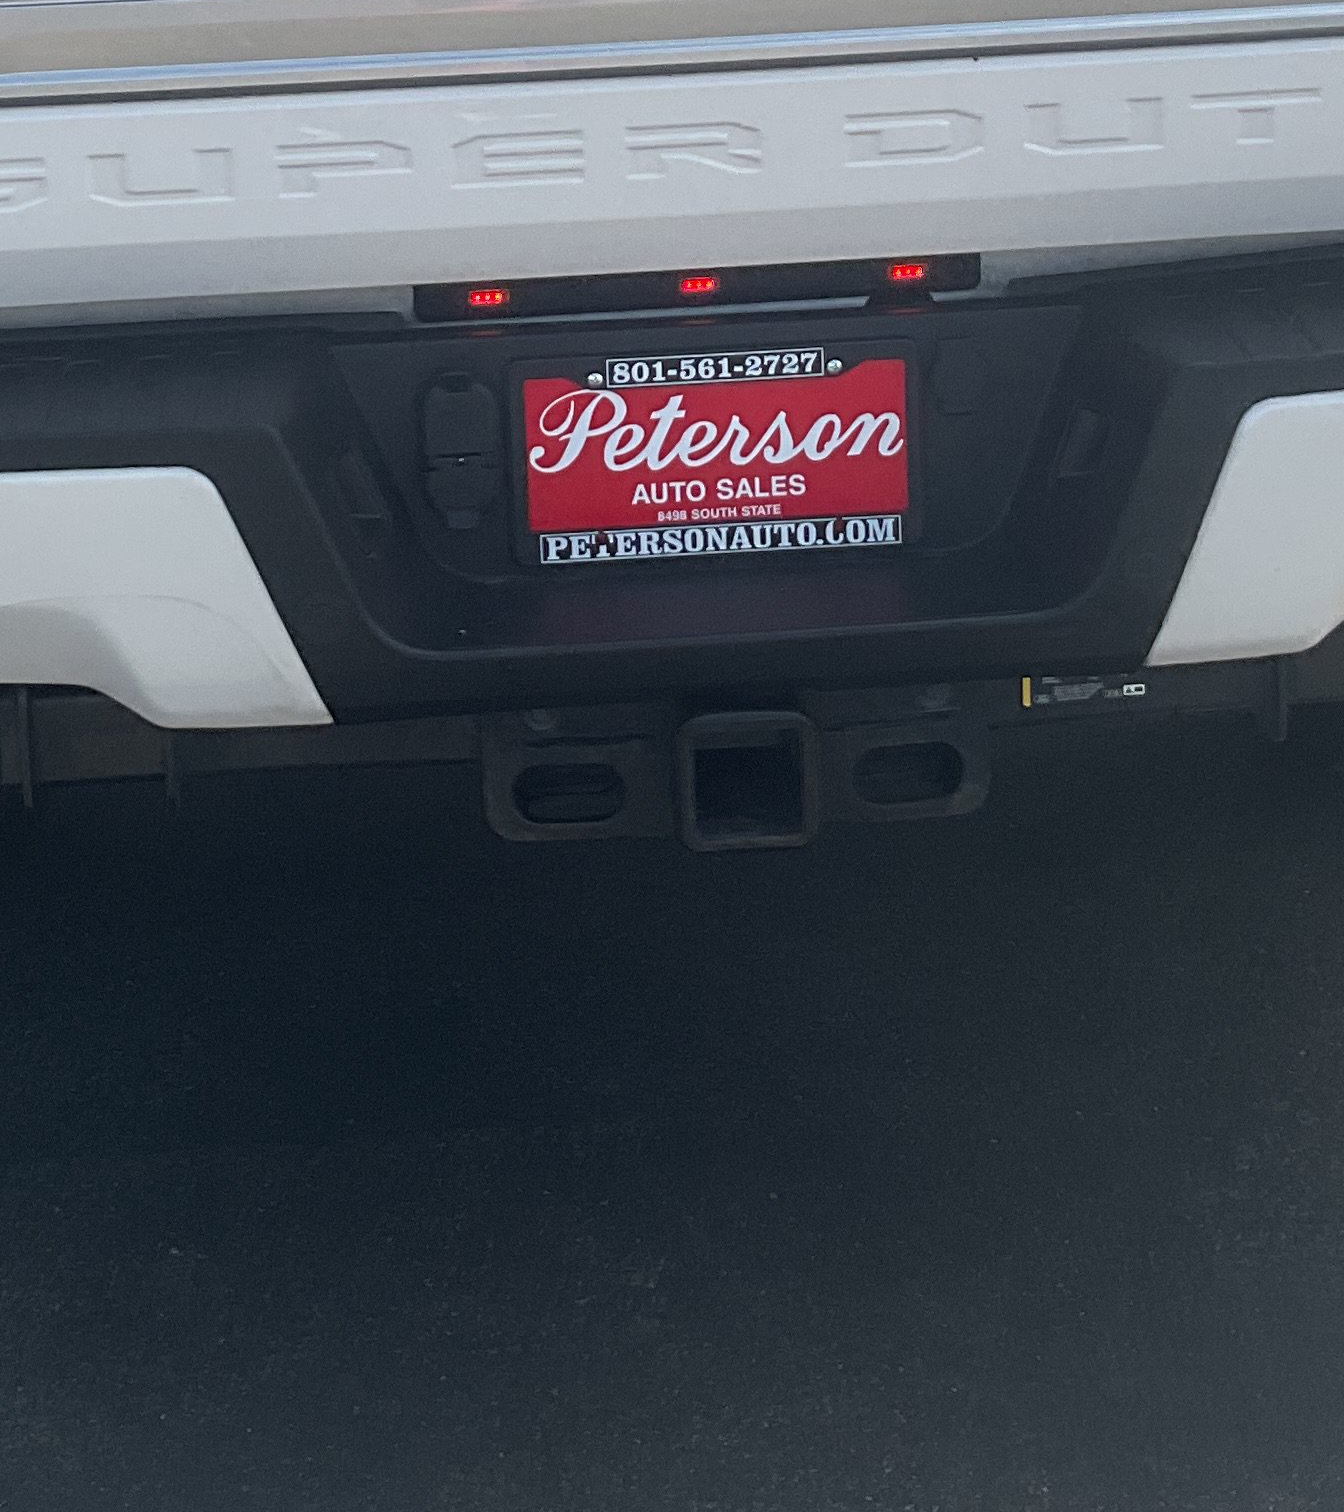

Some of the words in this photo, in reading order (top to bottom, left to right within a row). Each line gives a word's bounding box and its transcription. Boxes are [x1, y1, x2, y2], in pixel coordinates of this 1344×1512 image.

[613, 352, 818, 384] 801-561-2727
[530, 388, 904, 474] Peterson
[632, 480, 706, 505] AUTO
[716, 474, 807, 501] SALES
[691, 507, 738, 520] SOUTH
[741, 503, 782, 517] STATE
[546, 518, 896, 561] PETERSONAUTO.COM
